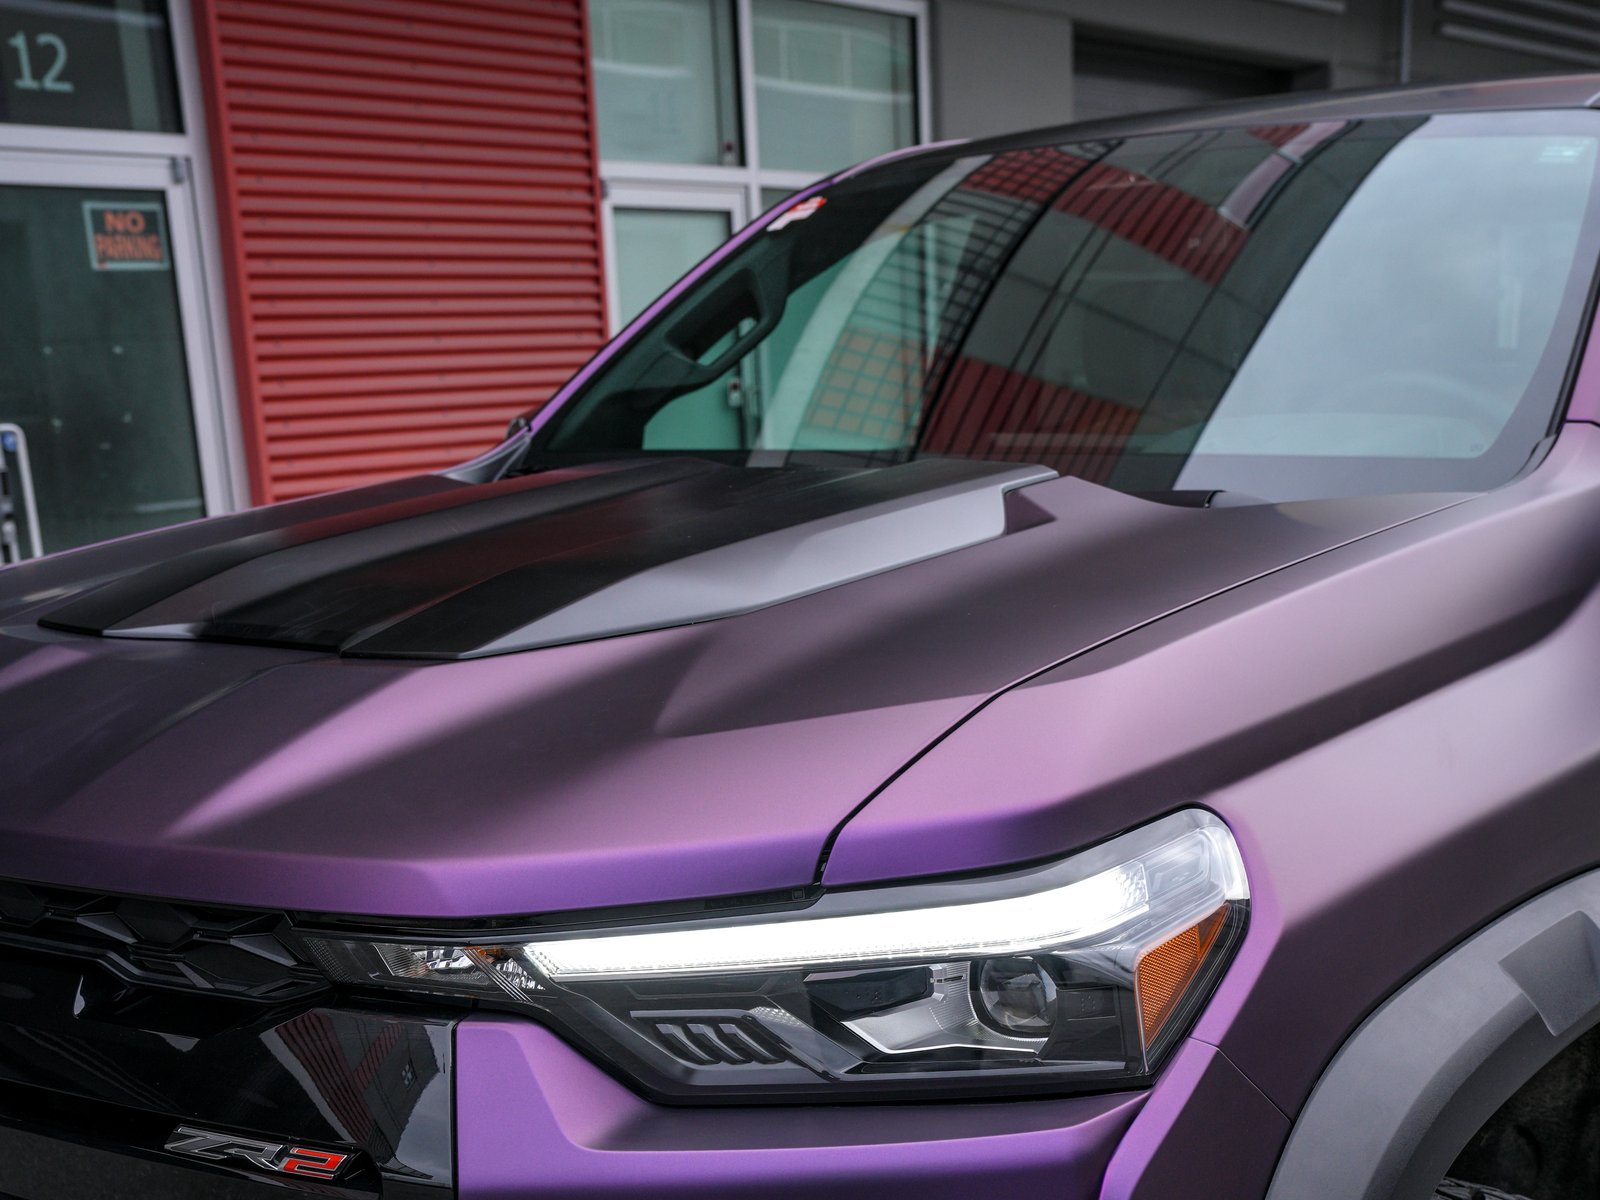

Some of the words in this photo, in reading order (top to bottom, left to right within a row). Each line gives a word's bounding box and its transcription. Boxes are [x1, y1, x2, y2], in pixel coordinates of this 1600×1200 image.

[9, 31, 74, 92] 12
[102, 209, 146, 234] NO
[164, 1123, 348, 1180] ZR2
